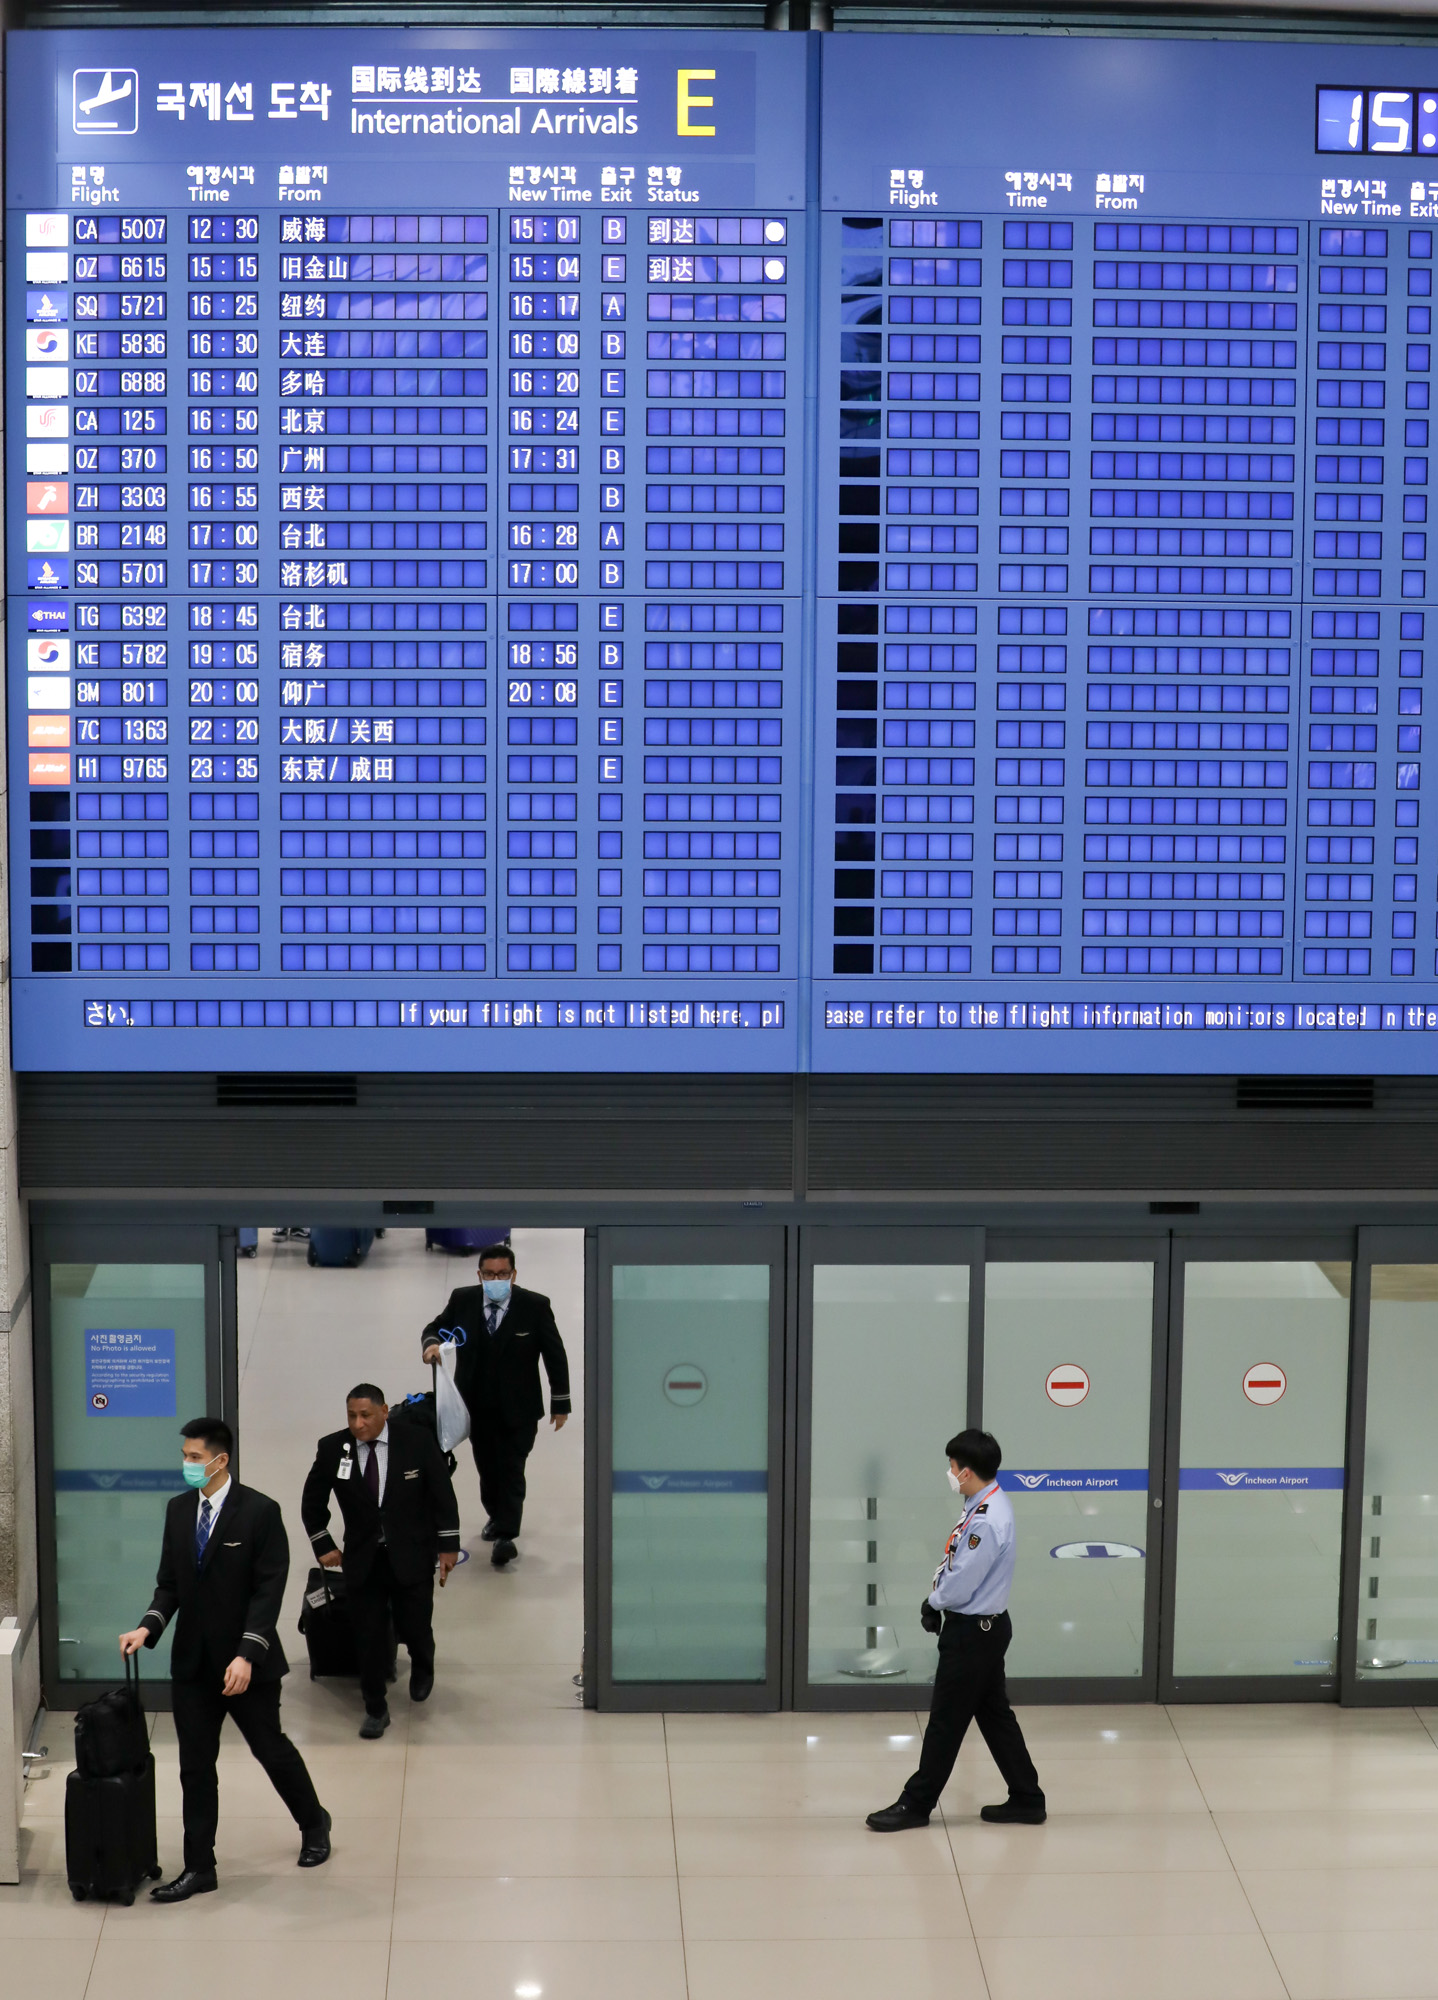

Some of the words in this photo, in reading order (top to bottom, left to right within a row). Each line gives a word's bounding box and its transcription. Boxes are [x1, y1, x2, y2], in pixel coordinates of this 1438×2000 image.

[352, 66, 481, 93] 国际线到达
[510, 67, 638, 94] 国際線到着
[157, 82, 254, 120] 국제선
[268, 82, 332, 120] 도착
[677, 69, 716, 136] E
[352, 107, 520, 134] International
[531, 107, 638, 134] Arrivals
[72, 166, 105, 185] 편명
[187, 166, 254, 185] 예정시각
[279, 165, 327, 184] 출발지
[509, 166, 576, 185] 변경시각
[601, 166, 635, 185] 출구
[648, 166, 682, 186] 현황
[890, 170, 923, 188] 편명
[1005, 172, 1072, 191] 예정시각
[1096, 173, 1144, 193] 출발지
[72, 187, 119, 205] Flight
[188, 186, 229, 201] Time
[279, 187, 321, 201] From
[509, 187, 547, 201] New
[550, 186, 592, 201] Time
[601, 187, 632, 202] Exit
[648, 187, 699, 202] Status
[1322, 179, 1386, 199] 변경시각
[890, 190, 938, 208] Flight
[1006, 192, 1047, 207] Time
[1096, 194, 1137, 209] From
[1321, 200, 1358, 214] New
[1361, 200, 1401, 216] Time
[1410, 202, 1438, 217] Exit
[76, 220, 97, 239] CA
[122, 219, 165, 238] 5007
[282, 217, 325, 242] 威海
[608, 219, 621, 239] B
[650, 219, 693, 243] 到达
[76, 258, 97, 277] OZ
[122, 258, 165, 277] 6615
[284, 256, 347, 279] 旧金山
[607, 258, 620, 277] E
[650, 257, 692, 281] 到达
[77, 296, 97, 316] SQ
[122, 296, 162, 315] 5721
[282, 294, 325, 317] 纽约
[607, 296, 620, 315] A
[77, 334, 97, 354] KE
[122, 334, 165, 353] 5836
[282, 332, 325, 356] 大连
[607, 335, 620, 354] B
[76, 373, 97, 392] OZ
[122, 372, 165, 391] 6888
[282, 371, 325, 394] 多哈
[607, 373, 619, 392] E
[76, 411, 97, 430] CA
[124, 411, 155, 430] 125
[282, 409, 324, 433] 北京
[607, 411, 618, 430] E
[77, 449, 97, 468] OZ
[122, 449, 156, 468] 370
[282, 447, 324, 471] 广州
[607, 450, 619, 469] B
[78, 487, 97, 506] ZH
[122, 487, 165, 506] 3303
[282, 485, 324, 509] 西安
[606, 488, 619, 507] B
[78, 526, 97, 545] BR
[122, 525, 165, 544] 2148
[283, 524, 325, 548] 台北
[605, 526, 619, 545] A
[78, 564, 98, 584] SQ
[122, 564, 163, 583] 5701
[282, 562, 347, 586] 洛杉矶
[606, 564, 619, 583] B
[44, 611, 66, 620] THAI
[78, 607, 98, 626] TG
[123, 607, 165, 626] 6392
[283, 605, 325, 629] 台北
[606, 607, 617, 626] E
[78, 645, 98, 664] KE
[123, 645, 166, 664] 5782
[282, 643, 325, 667] 宿务
[605, 645, 618, 664] B
[78, 683, 98, 702] 8M
[123, 683, 153, 702] 801
[282, 681, 325, 705] 仰广
[605, 683, 616, 702] E
[78, 720, 98, 739] 7C
[125, 720, 166, 740] 1363
[605, 721, 616, 740] E
[79, 759, 96, 777] H1
[124, 759, 166, 778] 9765
[605, 759, 616, 778] E
[88, 1002, 134, 1025] さい。
[401, 1003, 417, 1022] If
[430, 1009, 467, 1025] your
[482, 1004, 542, 1025] flight
[559, 1004, 574, 1023] is
[586, 1005, 615, 1023] not
[630, 1004, 689, 1023] listed
[700, 1005, 748, 1026] here,
[763, 1005, 779, 1026] pl
[827, 1010, 864, 1023] ease
[877, 1005, 925, 1024] refer
[939, 1006, 957, 1024] to
[969, 1005, 998, 1024] the
[1010, 1005, 1069, 1027] flight
[1084, 1005, 1192, 1024] information
[1299, 1007, 1366, 1025] located
[1046, 1478, 1083, 1487] Incheon
[1085, 1477, 1119, 1490] Airport
[1245, 1476, 1277, 1485] Incheon
[1279, 1475, 1309, 1488] Airport
